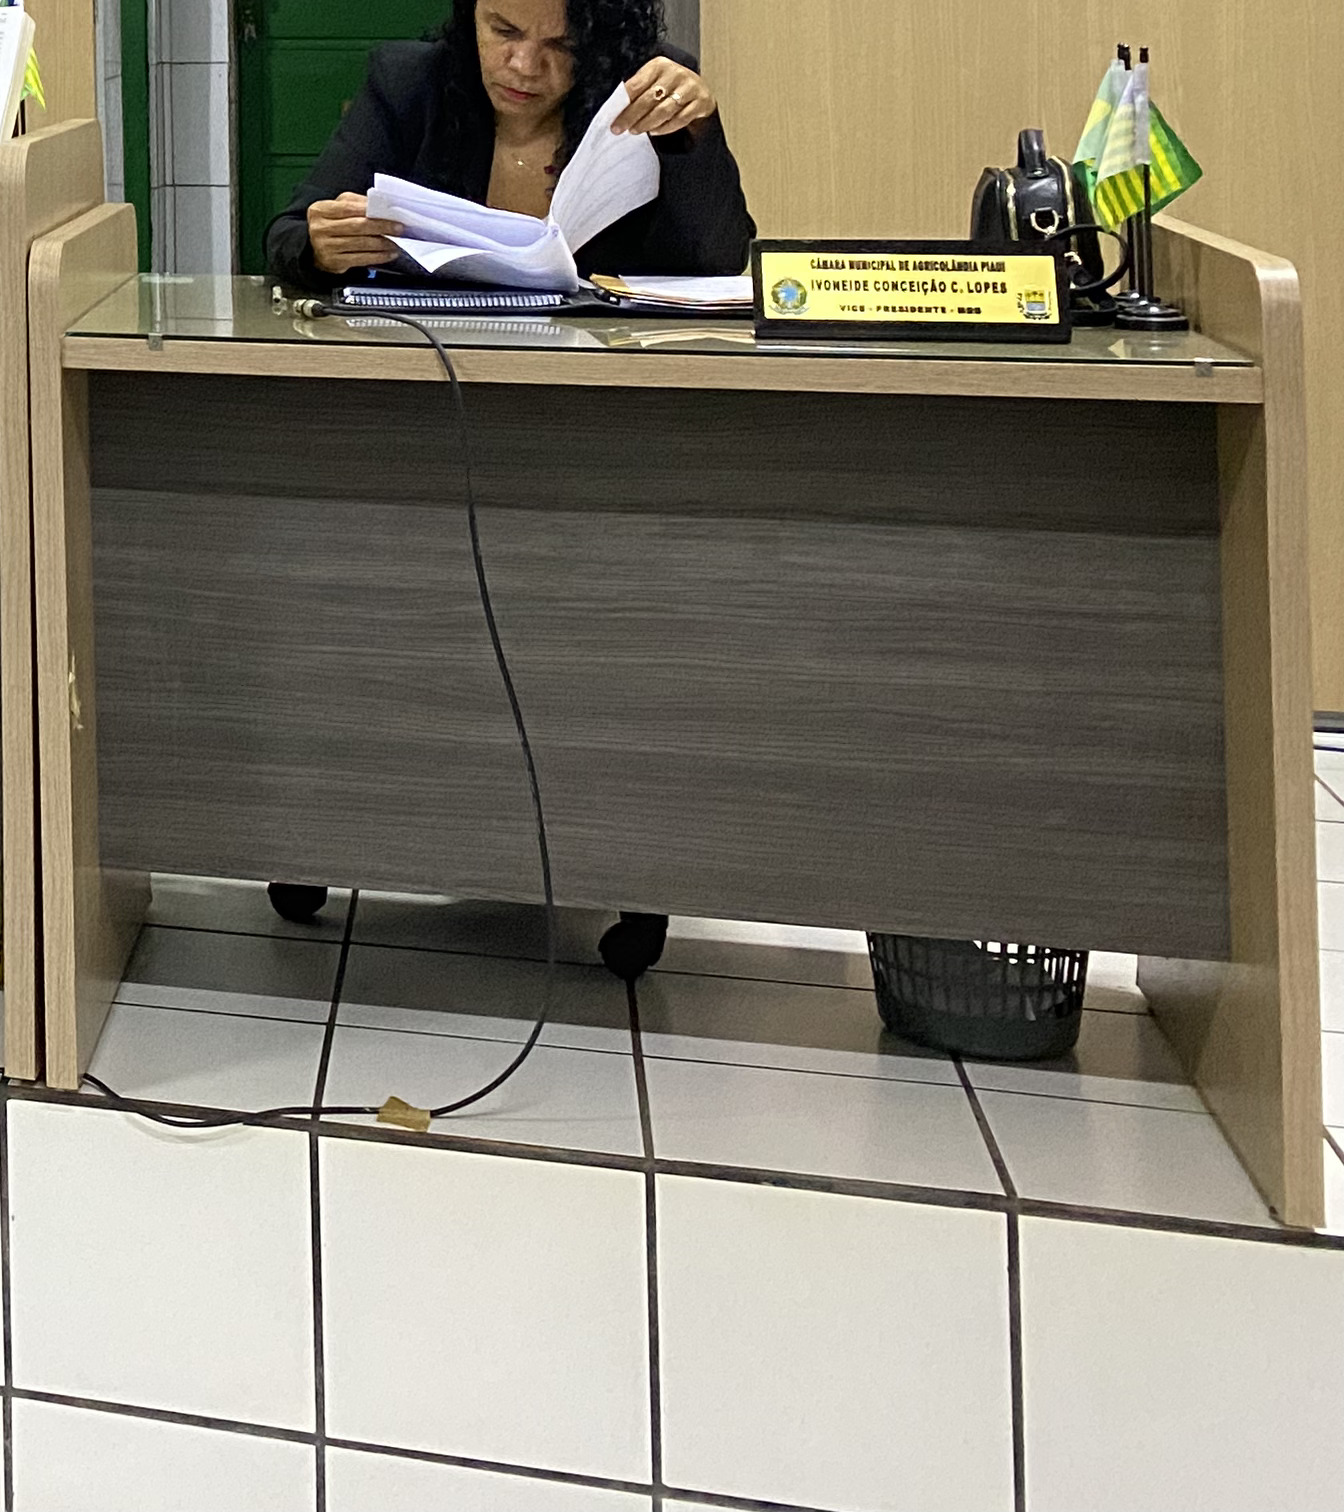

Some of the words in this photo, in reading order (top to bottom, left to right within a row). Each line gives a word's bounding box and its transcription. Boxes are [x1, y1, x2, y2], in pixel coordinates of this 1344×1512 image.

[810, 257, 846, 270] CÂMARA
[849, 260, 897, 271] MUNICIPAL
[899, 260, 910, 271] DE
[912, 259, 978, 272] AGRICOLÂNDIA
[811, 280, 869, 292] IVONEIDE
[873, 279, 947, 296] CONCEIÇÃO
[951, 282, 964, 293] C.
[967, 281, 1007, 294] LOPES
[840, 304, 865, 313] VICE
[876, 305, 947, 314] PRESIDENTE
